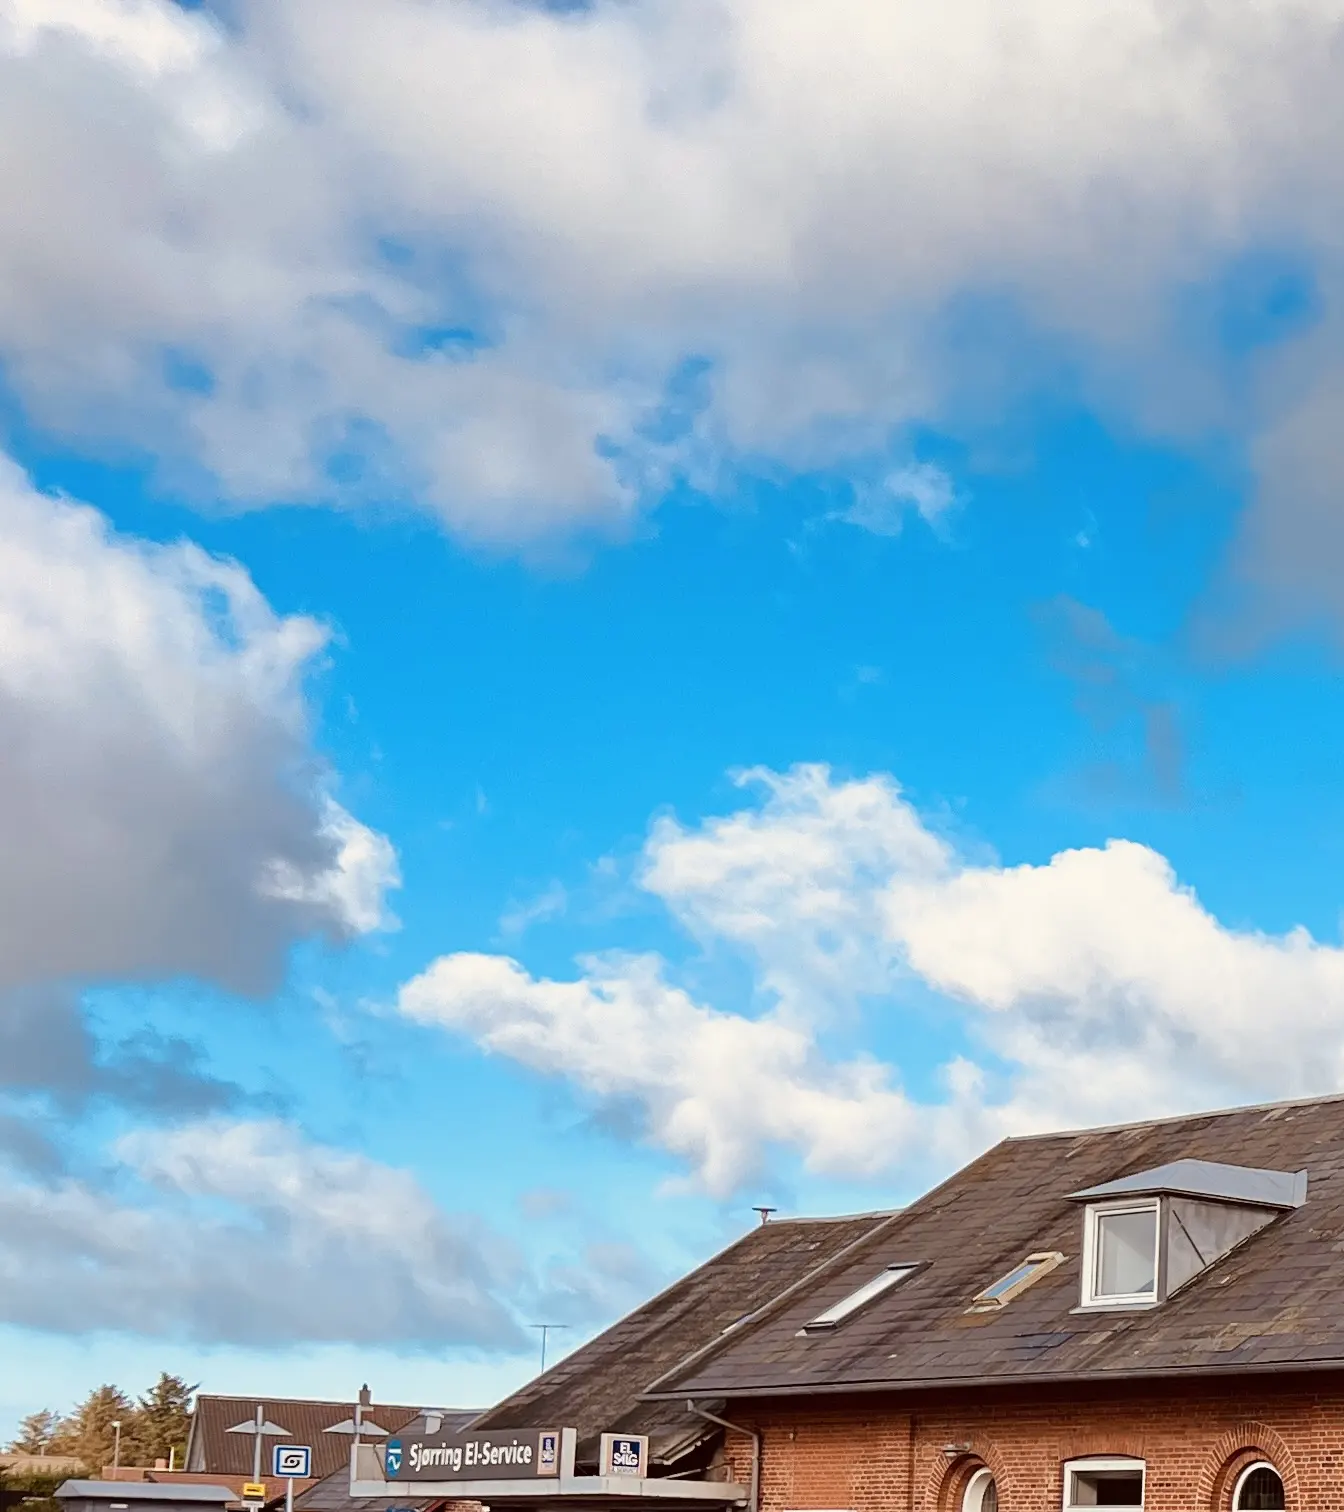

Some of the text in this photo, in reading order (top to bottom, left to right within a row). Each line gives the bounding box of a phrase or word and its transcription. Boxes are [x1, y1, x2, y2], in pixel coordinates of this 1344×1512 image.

[619, 1441, 633, 1454] EL
[409, 1439, 532, 1472] Sjørring El-Service
[613, 1452, 638, 1466] SALG
